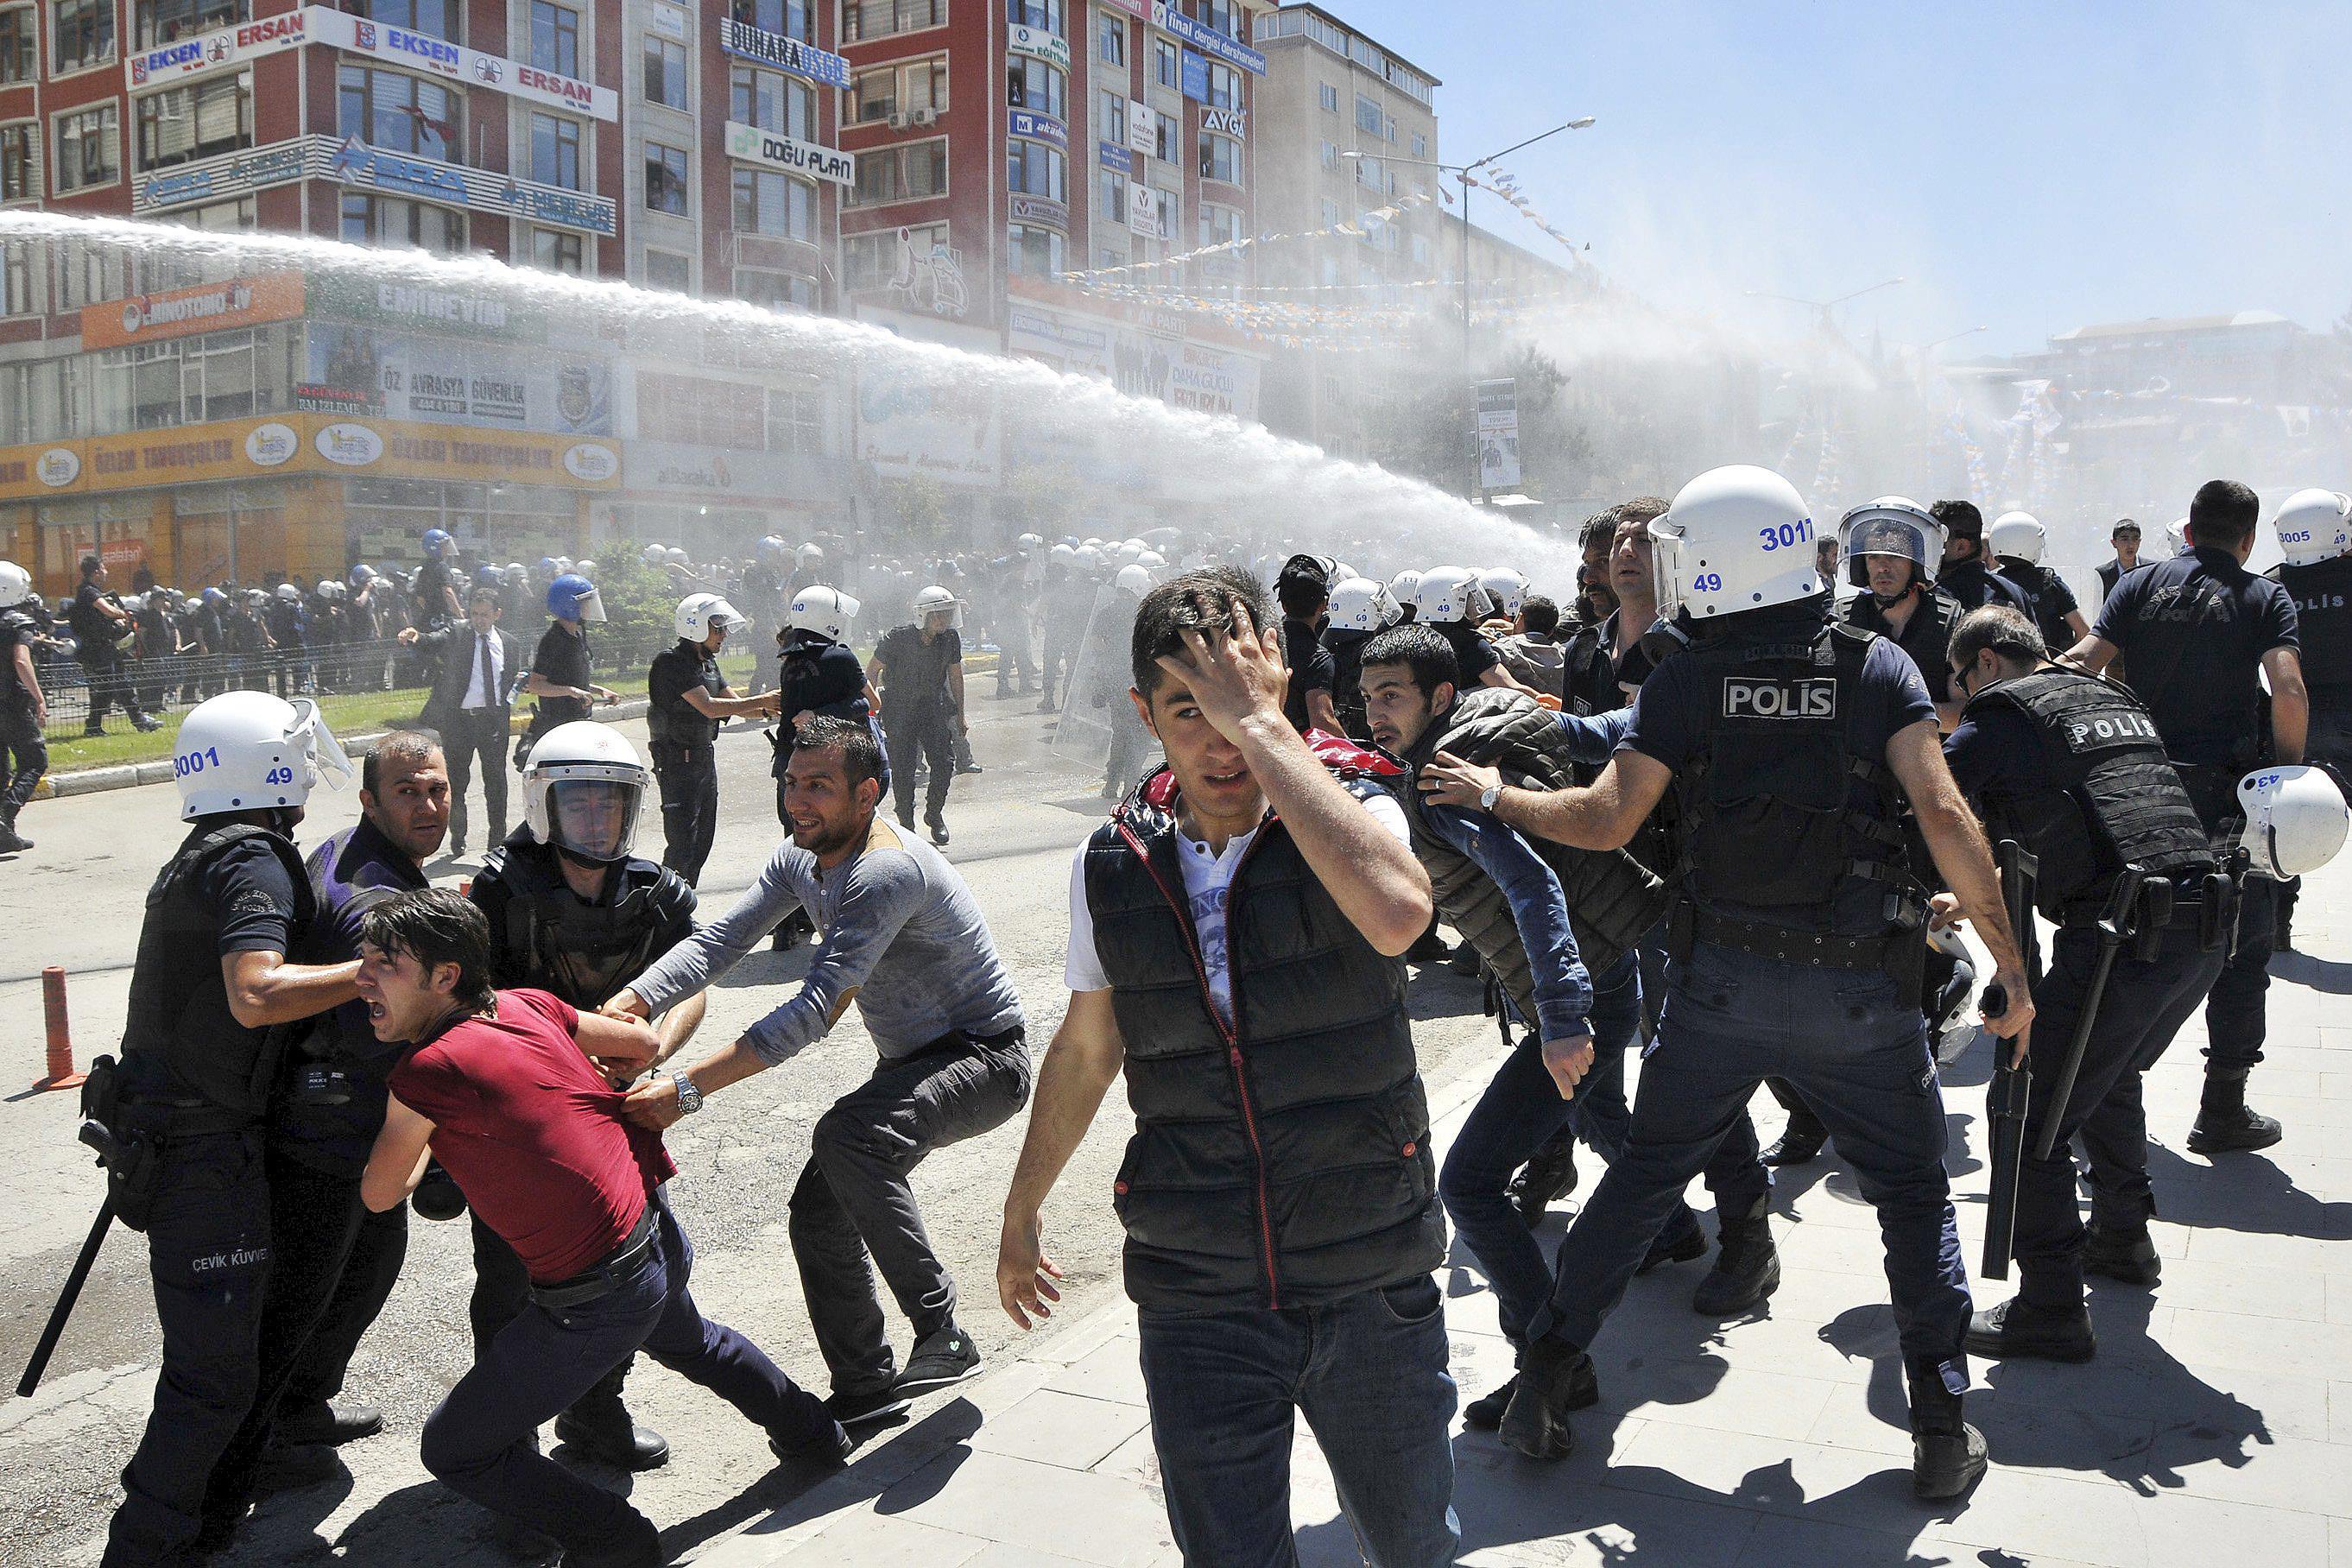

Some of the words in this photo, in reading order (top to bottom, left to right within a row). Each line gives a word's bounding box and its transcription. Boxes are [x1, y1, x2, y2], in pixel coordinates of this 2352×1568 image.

[237, 13, 303, 47] ERSAN
[1167, 11, 1192, 38] final
[149, 41, 202, 71] EKSEN
[389, 29, 459, 65] EKSEN
[518, 66, 591, 104] ERSAN
[762, 138, 805, 167] DOĞU
[808, 151, 850, 179] PLAN
[410, 373, 465, 398] AVRASYA
[1760, 517, 1814, 552] 3017
[2279, 530, 2310, 543] 3005
[2334, 533, 2346, 545] 49
[1694, 572, 1722, 592] 49
[1438, 604, 1451, 613] 49
[1729, 683, 1832, 716] POLİS
[2071, 713, 2157, 743] POLİS
[173, 746, 220, 778] 3001
[265, 767, 293, 785] 49
[193, 1252, 227, 1274] ÇEVİK
